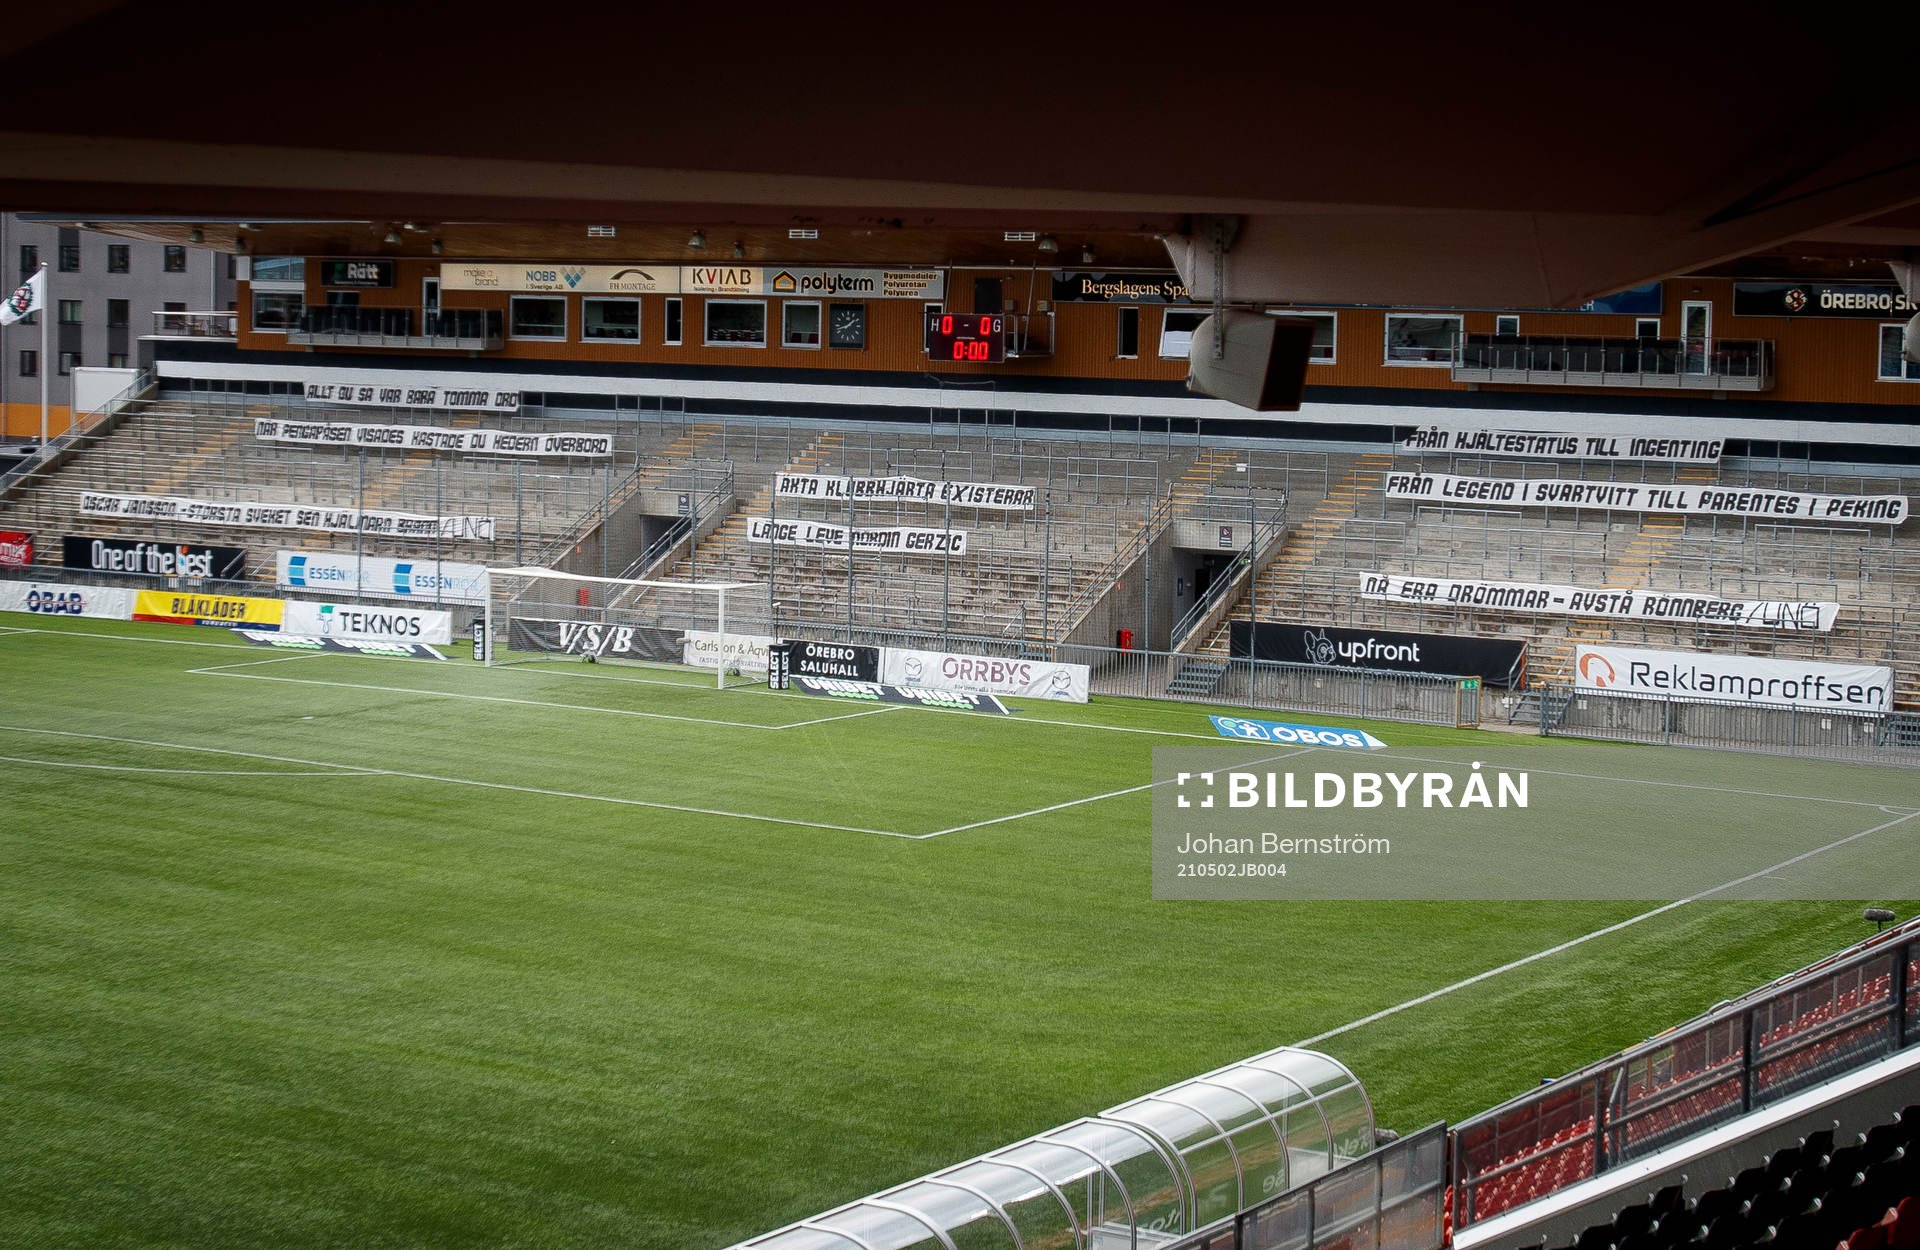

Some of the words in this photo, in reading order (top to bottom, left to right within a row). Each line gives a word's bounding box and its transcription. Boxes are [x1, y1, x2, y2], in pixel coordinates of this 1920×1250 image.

[526, 271, 557, 282] NOBB
[621, 282, 655, 291] MONTAGE
[692, 268, 751, 285] KVIAB
[801, 272, 874, 294] polyterm
[883, 280, 927, 289] Polyuretan
[1082, 279, 1161, 299] Bergslagens
[1820, 289, 1891, 310] ÖREBRO
[930, 318, 939, 331] H
[942, 315, 953, 335] 0
[980, 316, 991, 335] 0
[993, 319, 1001, 332] G
[953, 341, 989, 360] 0:00
[306, 384, 335, 400] ALLT
[380, 388, 401, 403] VAR
[406, 389, 436, 405] BARA
[443, 390, 489, 407] TOMMA
[495, 392, 519, 407] ORD
[357, 428, 404, 444] VISADES
[411, 430, 464, 449] KASTADE
[469, 434, 487, 449] DU
[493, 434, 540, 452] HEDERN
[1406, 425, 1449, 449] FRÅN
[1455, 429, 1578, 455] HJÄLTESTATUS
[1586, 437, 1619, 457] TILL
[1629, 438, 1721, 459] INGENTING
[780, 473, 819, 495] ÄKTA
[940, 483, 1034, 506] EXISTERAR
[1386, 471, 1433, 495] FRÅN
[1442, 479, 1515, 501] LEGEND
[1535, 483, 1638, 506] SVARTVITT
[1647, 489, 1688, 509] TILL
[1698, 490, 1800, 514] PARENTES
[1826, 499, 1902, 519] PEKING
[83, 494, 120, 512] OSCAR
[91, 540, 123, 571] One
[124, 542, 145, 572] of
[146, 545, 175, 574] the
[176, 545, 213, 578] best
[27, 584, 82, 614] ÖBAB
[172, 595, 247, 619] BLÅKLÄDER
[1399, 581, 1439, 601] ERA
[1448, 583, 1550, 609] DRÖMMAR
[1569, 589, 1633, 613] AVSTÅ
[339, 612, 421, 636] TEKNOS
[473, 624, 484, 660] SELECT
[695, 639, 736, 654] Carlson
[805, 643, 855, 660] ÖREBRO
[1339, 638, 1420, 663] upfront
[770, 651, 780, 689] SELECT
[781, 651, 789, 689] SELECT
[800, 660, 859, 677] SALUHALL
[942, 656, 1031, 686] ORRBYS
[1630, 661, 1885, 705] Reklamproffsen
[1272, 727, 1362, 747] OBOS
